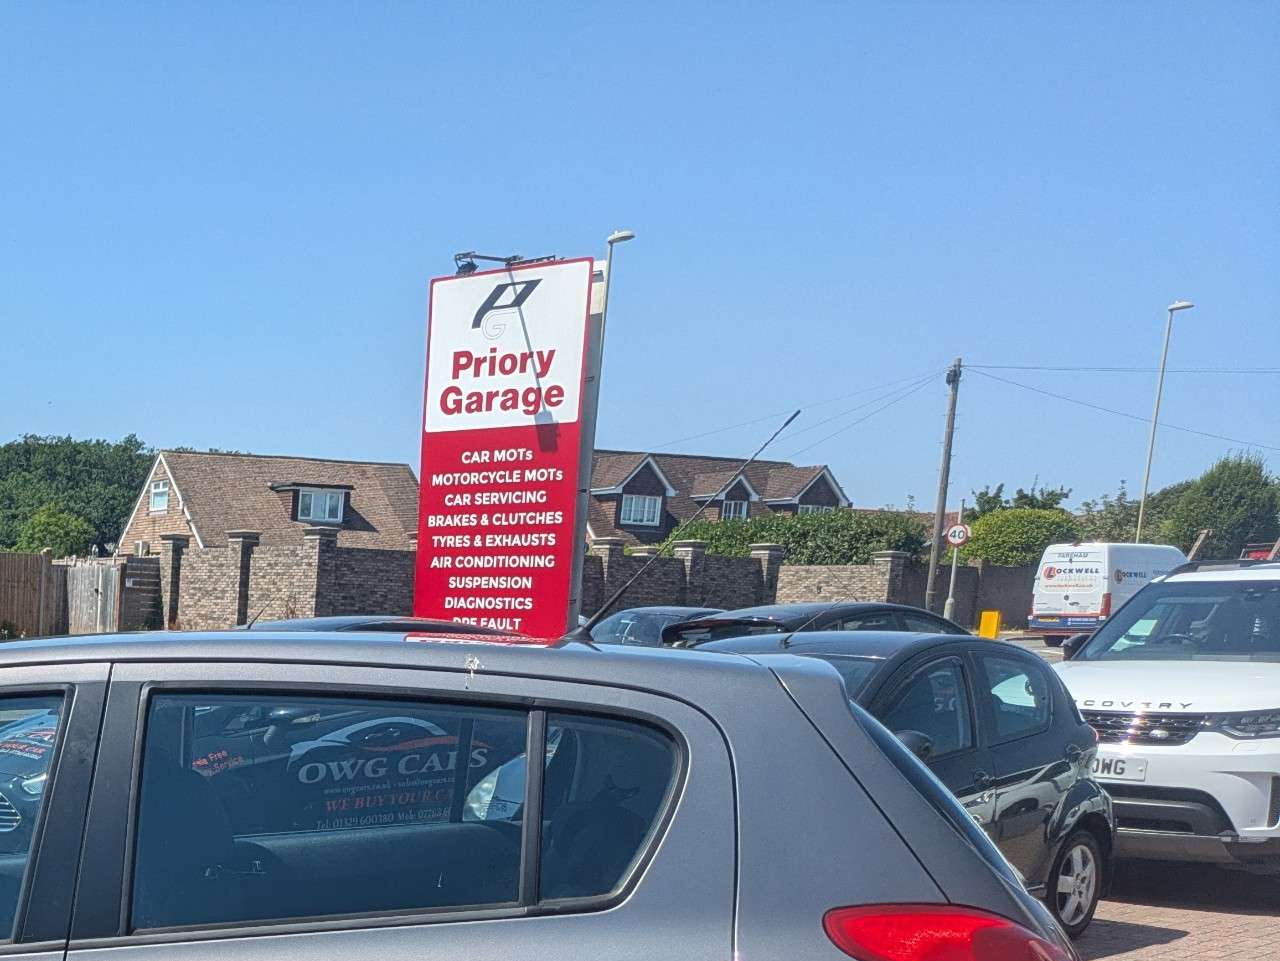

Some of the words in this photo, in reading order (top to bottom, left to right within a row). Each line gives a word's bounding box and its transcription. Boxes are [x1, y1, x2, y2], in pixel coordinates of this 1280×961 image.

[452, 347, 556, 380] Priory
[439, 385, 565, 416] Garage
[461, 451, 490, 464] CAR
[493, 448, 533, 463] MOTs
[432, 470, 521, 486] MOTORCYCLE
[524, 468, 563, 482] MOTs
[444, 494, 471, 506] CAR
[474, 491, 547, 505] SERVICING
[427, 514, 477, 527] BRAKES
[480, 514, 489, 526] &
[492, 511, 563, 526] CLUTCHES
[432, 535, 470, 548] TYRES
[473, 535, 482, 547] &
[485, 533, 556, 547] EXHAUSTS
[950, 529, 965, 539] 40
[430, 556, 452, 569] AIR
[455, 555, 556, 568] CONDITIONING
[448, 576, 532, 589] SUSPENSION
[444, 597, 533, 609] DIAGNOSTICS
[480, 617, 522, 630] FAULT
[297, 756, 387, 784] OWG
[325, 798, 349, 813] WE
[354, 795, 385, 809] BUY
